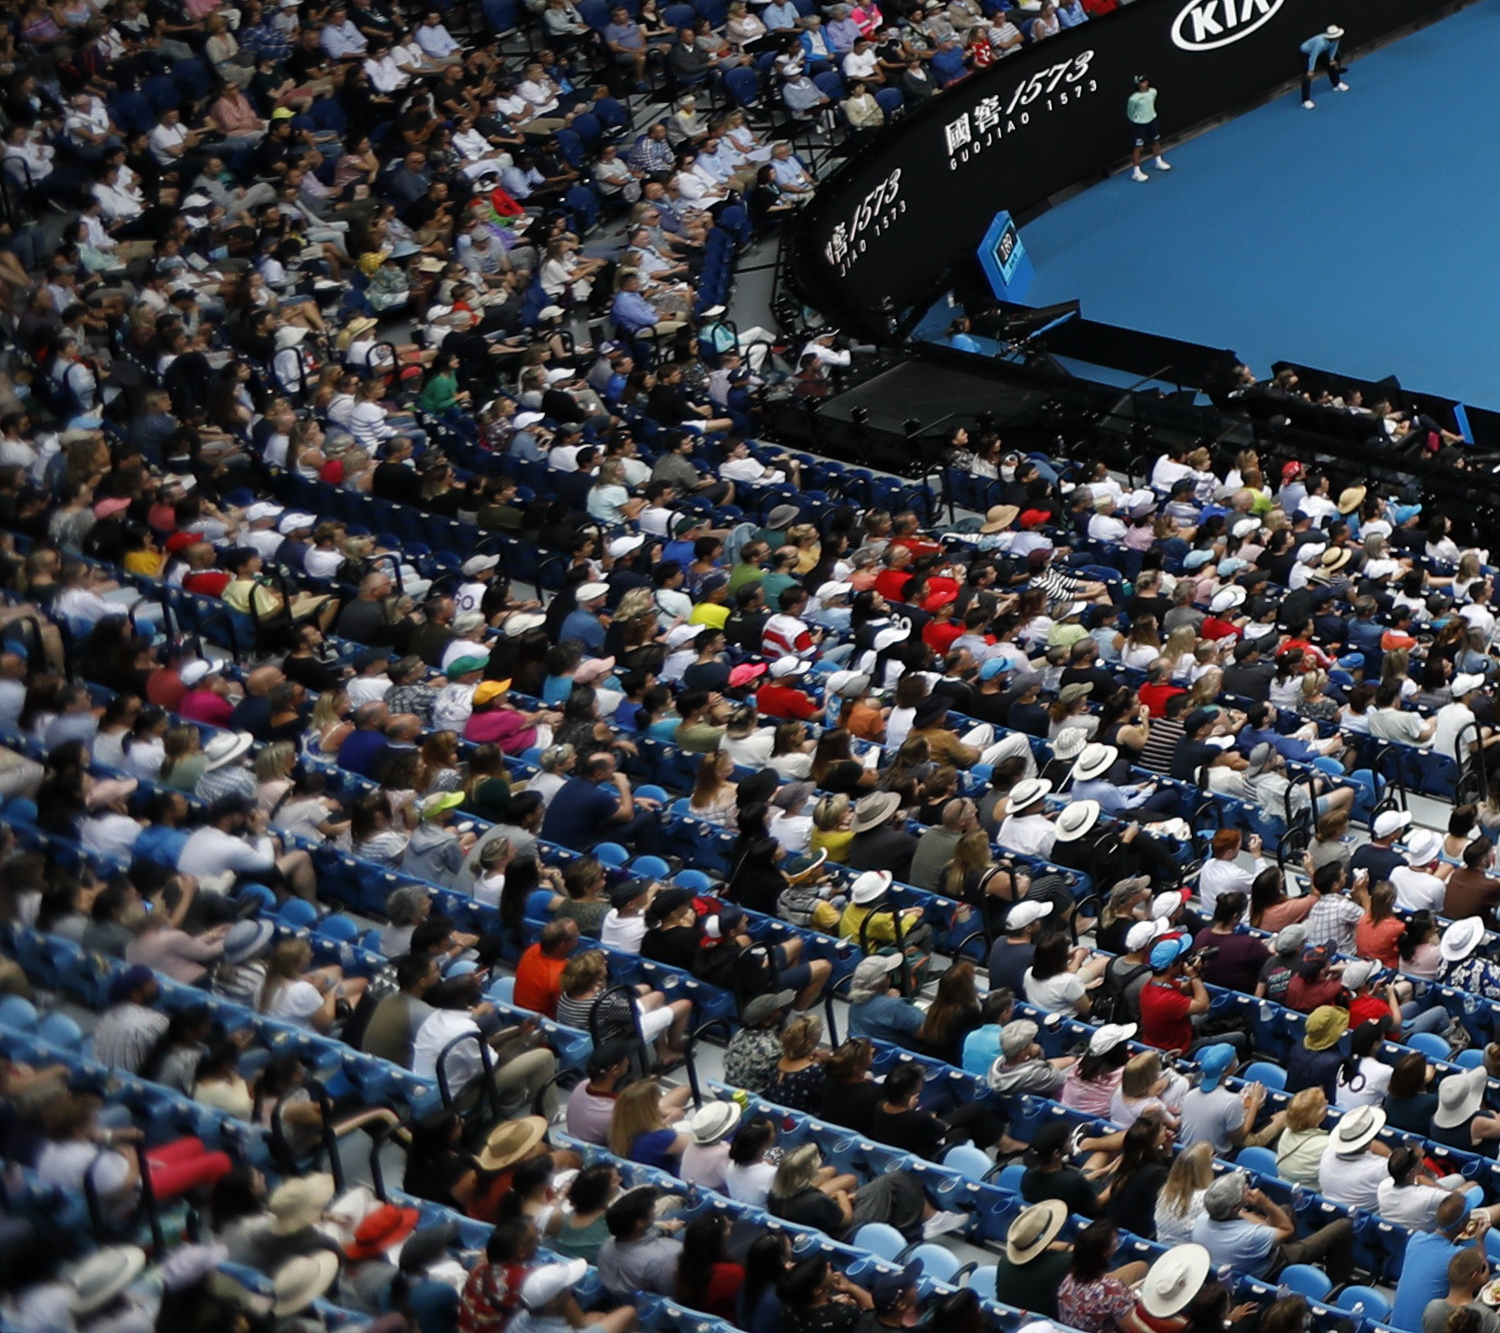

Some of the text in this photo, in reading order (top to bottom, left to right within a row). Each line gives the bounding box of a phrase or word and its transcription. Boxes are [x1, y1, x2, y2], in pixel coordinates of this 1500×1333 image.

[950, 79, 1098, 171] GUOJIAO 1573
[875, 200, 907, 237] 1573
